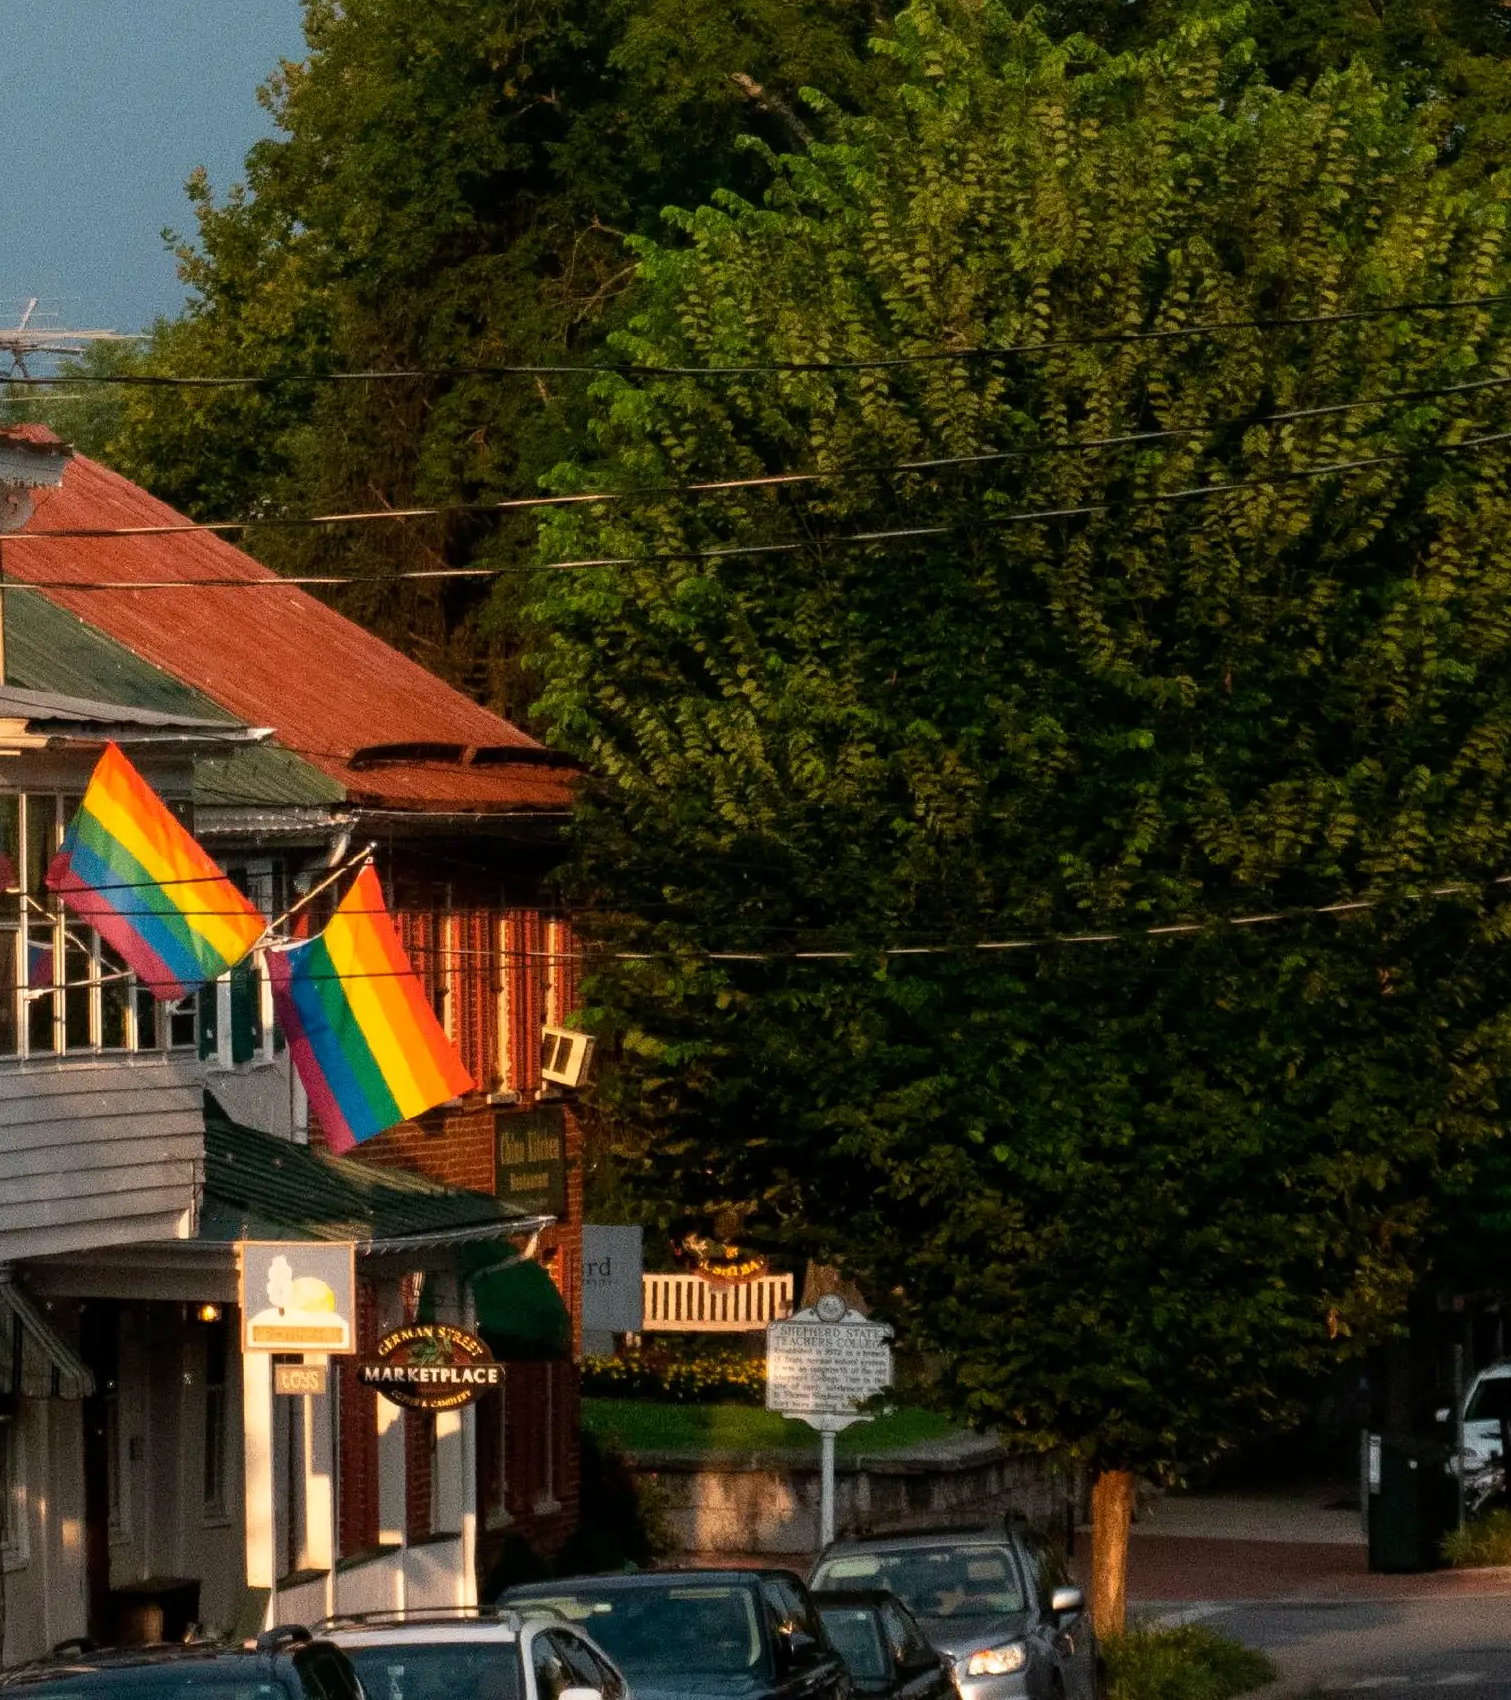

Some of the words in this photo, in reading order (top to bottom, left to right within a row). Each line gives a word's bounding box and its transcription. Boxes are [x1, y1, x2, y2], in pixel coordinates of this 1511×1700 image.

[781, 1326, 841, 1338] SHEPHERD
[378, 1326, 433, 1356] GERMAN
[438, 1326, 483, 1357] STREET
[775, 1336, 833, 1347] TEACHERS
[364, 1367, 498, 1384] MARKETPLACE
